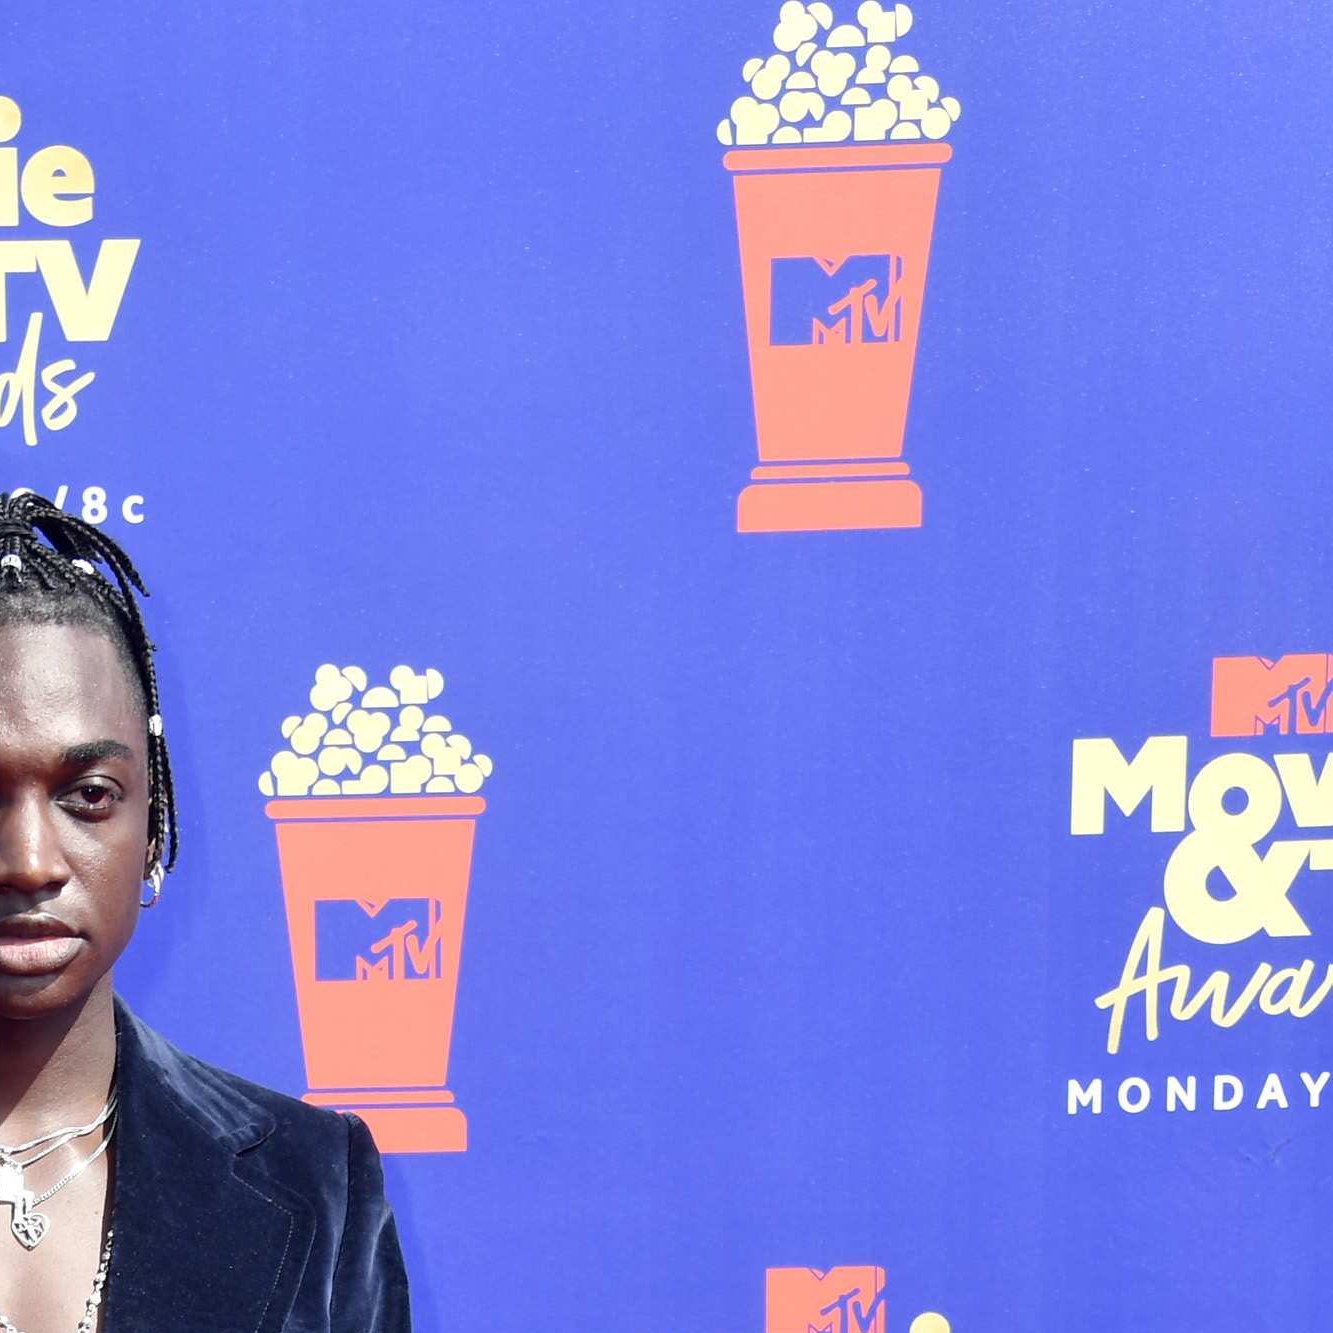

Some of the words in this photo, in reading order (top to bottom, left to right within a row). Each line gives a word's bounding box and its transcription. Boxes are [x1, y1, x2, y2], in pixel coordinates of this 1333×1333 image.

[769, 253, 903, 346] MTV
[1211, 653, 1333, 737] MTV
[314, 898, 441, 982] MTV
[1094, 906, 1333, 1054] Awa
[1067, 1072, 1331, 1114] MONDAY
